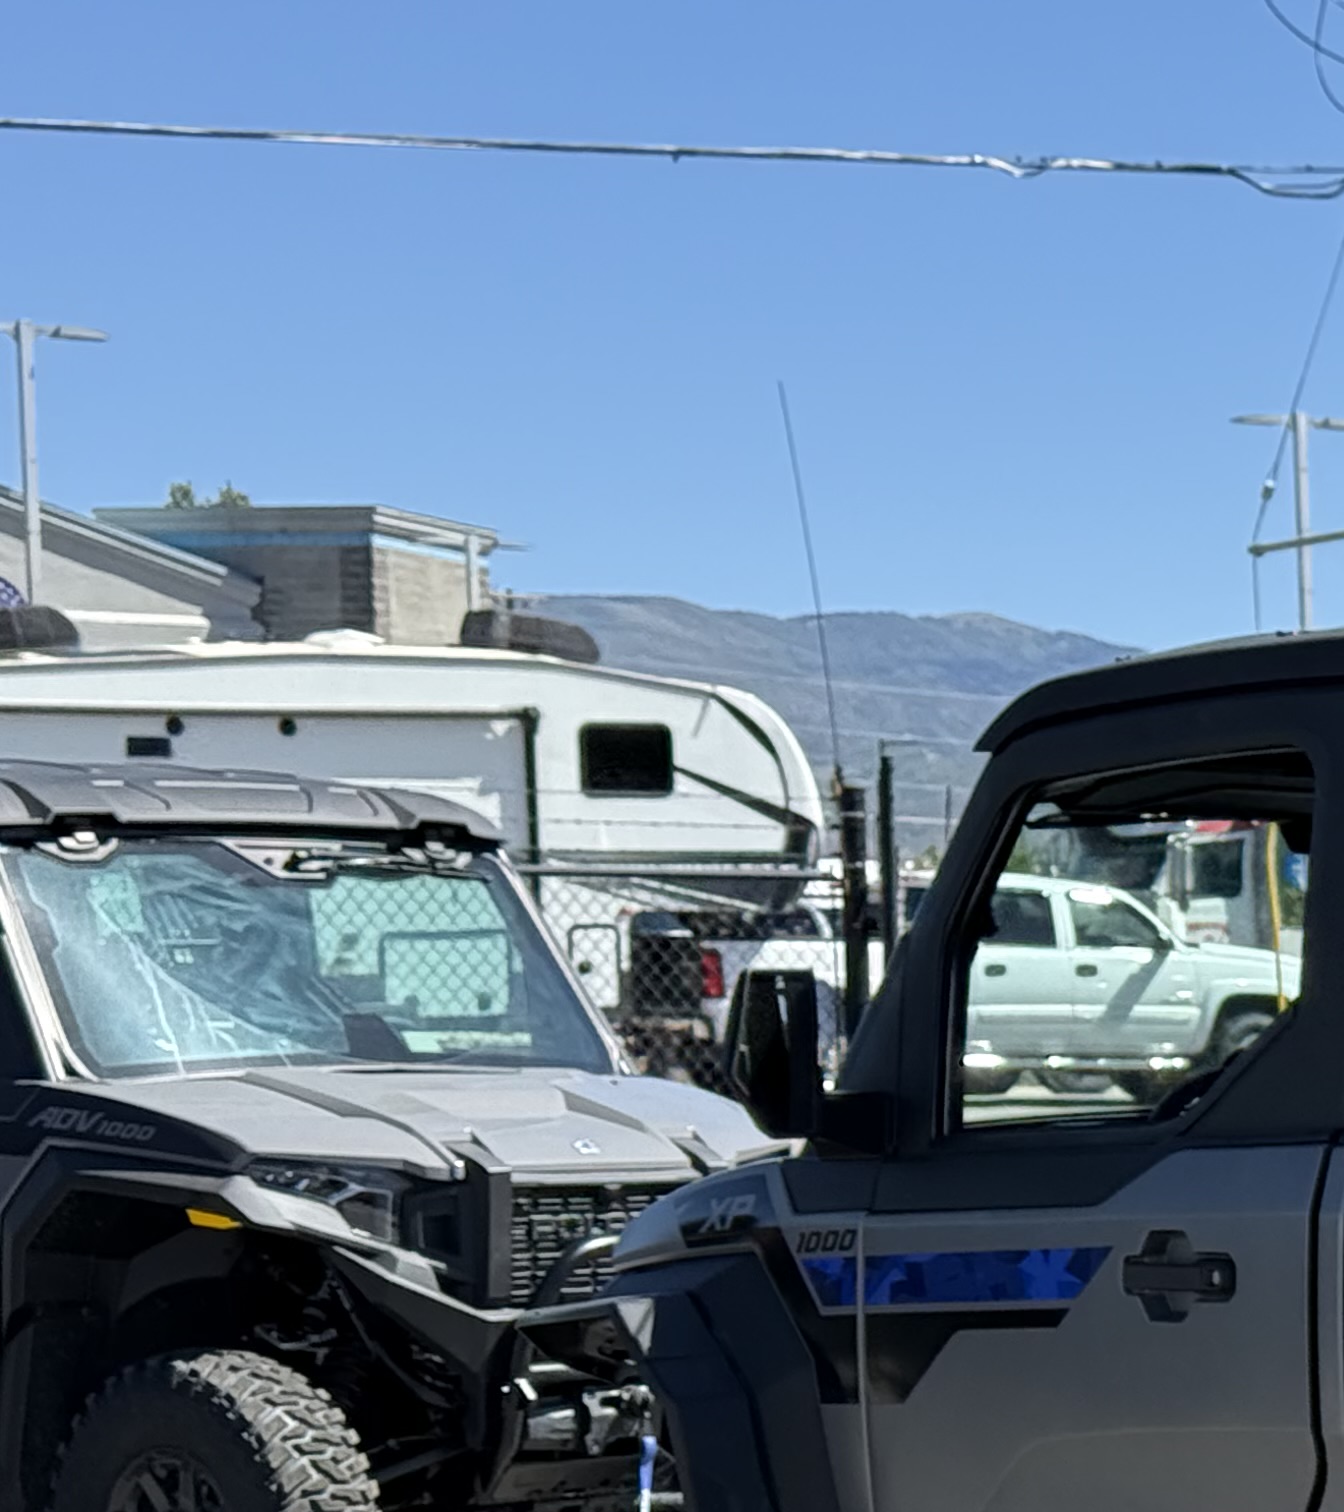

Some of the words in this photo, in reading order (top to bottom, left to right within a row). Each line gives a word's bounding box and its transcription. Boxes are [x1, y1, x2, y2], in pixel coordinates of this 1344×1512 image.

[27, 1106, 105, 1134] ADV
[96, 1119, 157, 1142] 1000
[697, 1193, 757, 1234] XP
[797, 1229, 858, 1253] 1000
